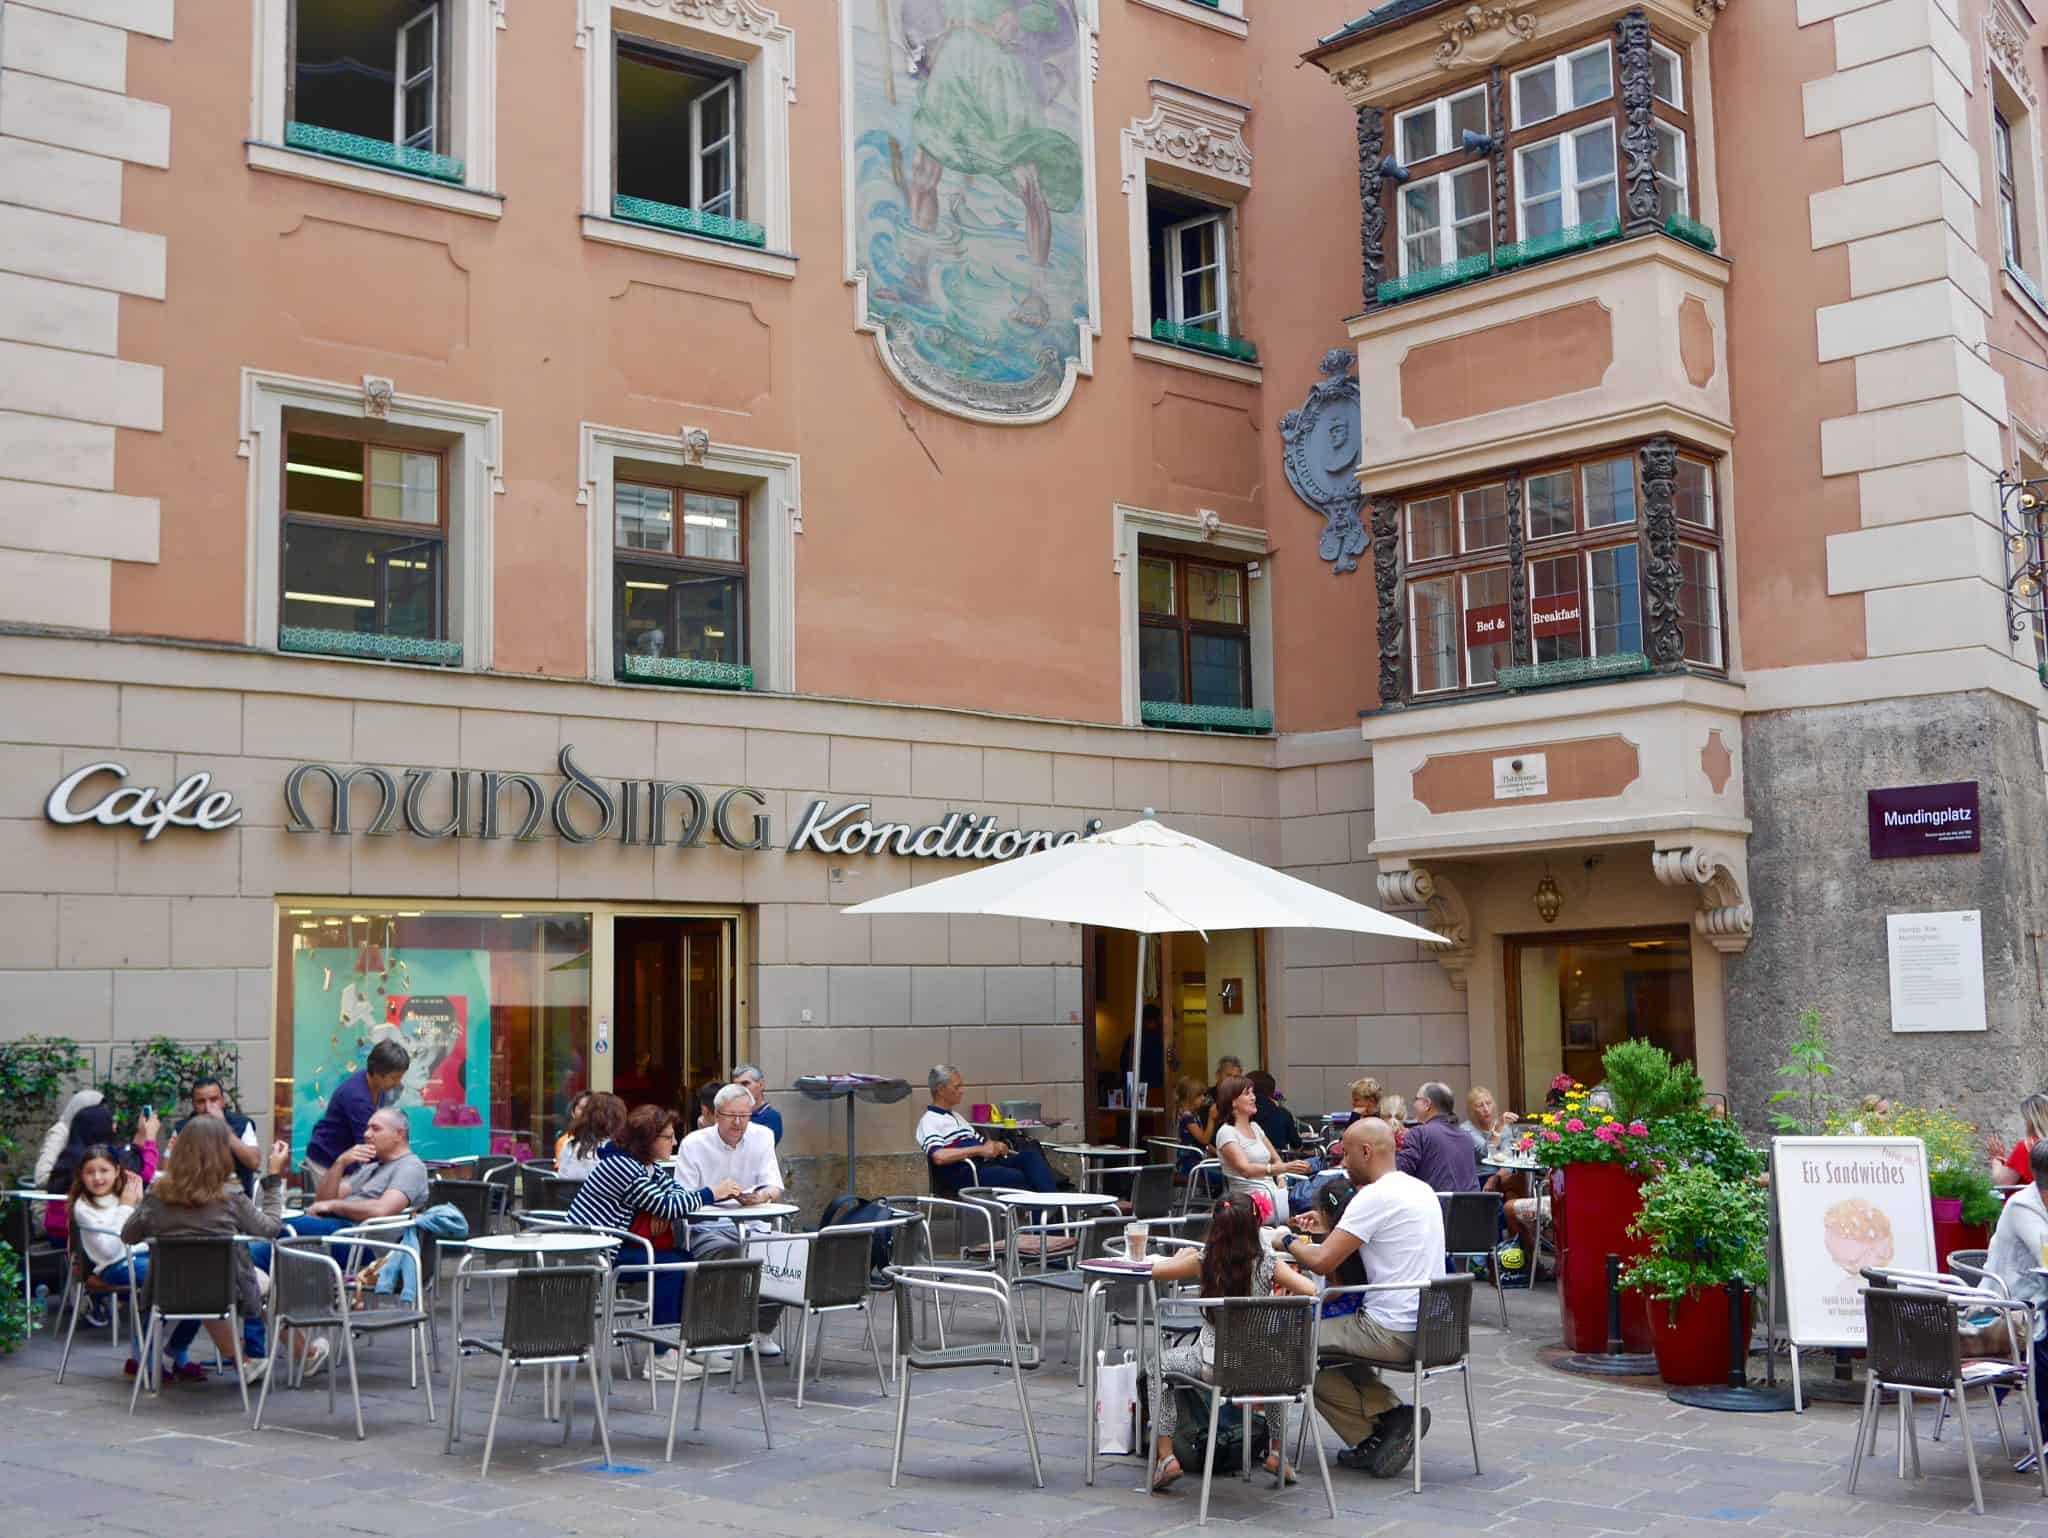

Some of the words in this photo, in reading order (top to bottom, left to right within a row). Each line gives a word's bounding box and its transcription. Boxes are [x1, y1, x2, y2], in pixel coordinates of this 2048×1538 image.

[1476, 620, 1494, 632] Bed
[1496, 618, 1505, 629] &
[1532, 607, 1580, 624] Breakfast
[44, 760, 243, 841] Cafe
[786, 799, 1103, 860] Konditor
[1884, 807, 1972, 826] Mundingplatz
[1802, 1160, 1820, 1184] Eis
[1826, 1160, 1905, 1185] Sandwiches
